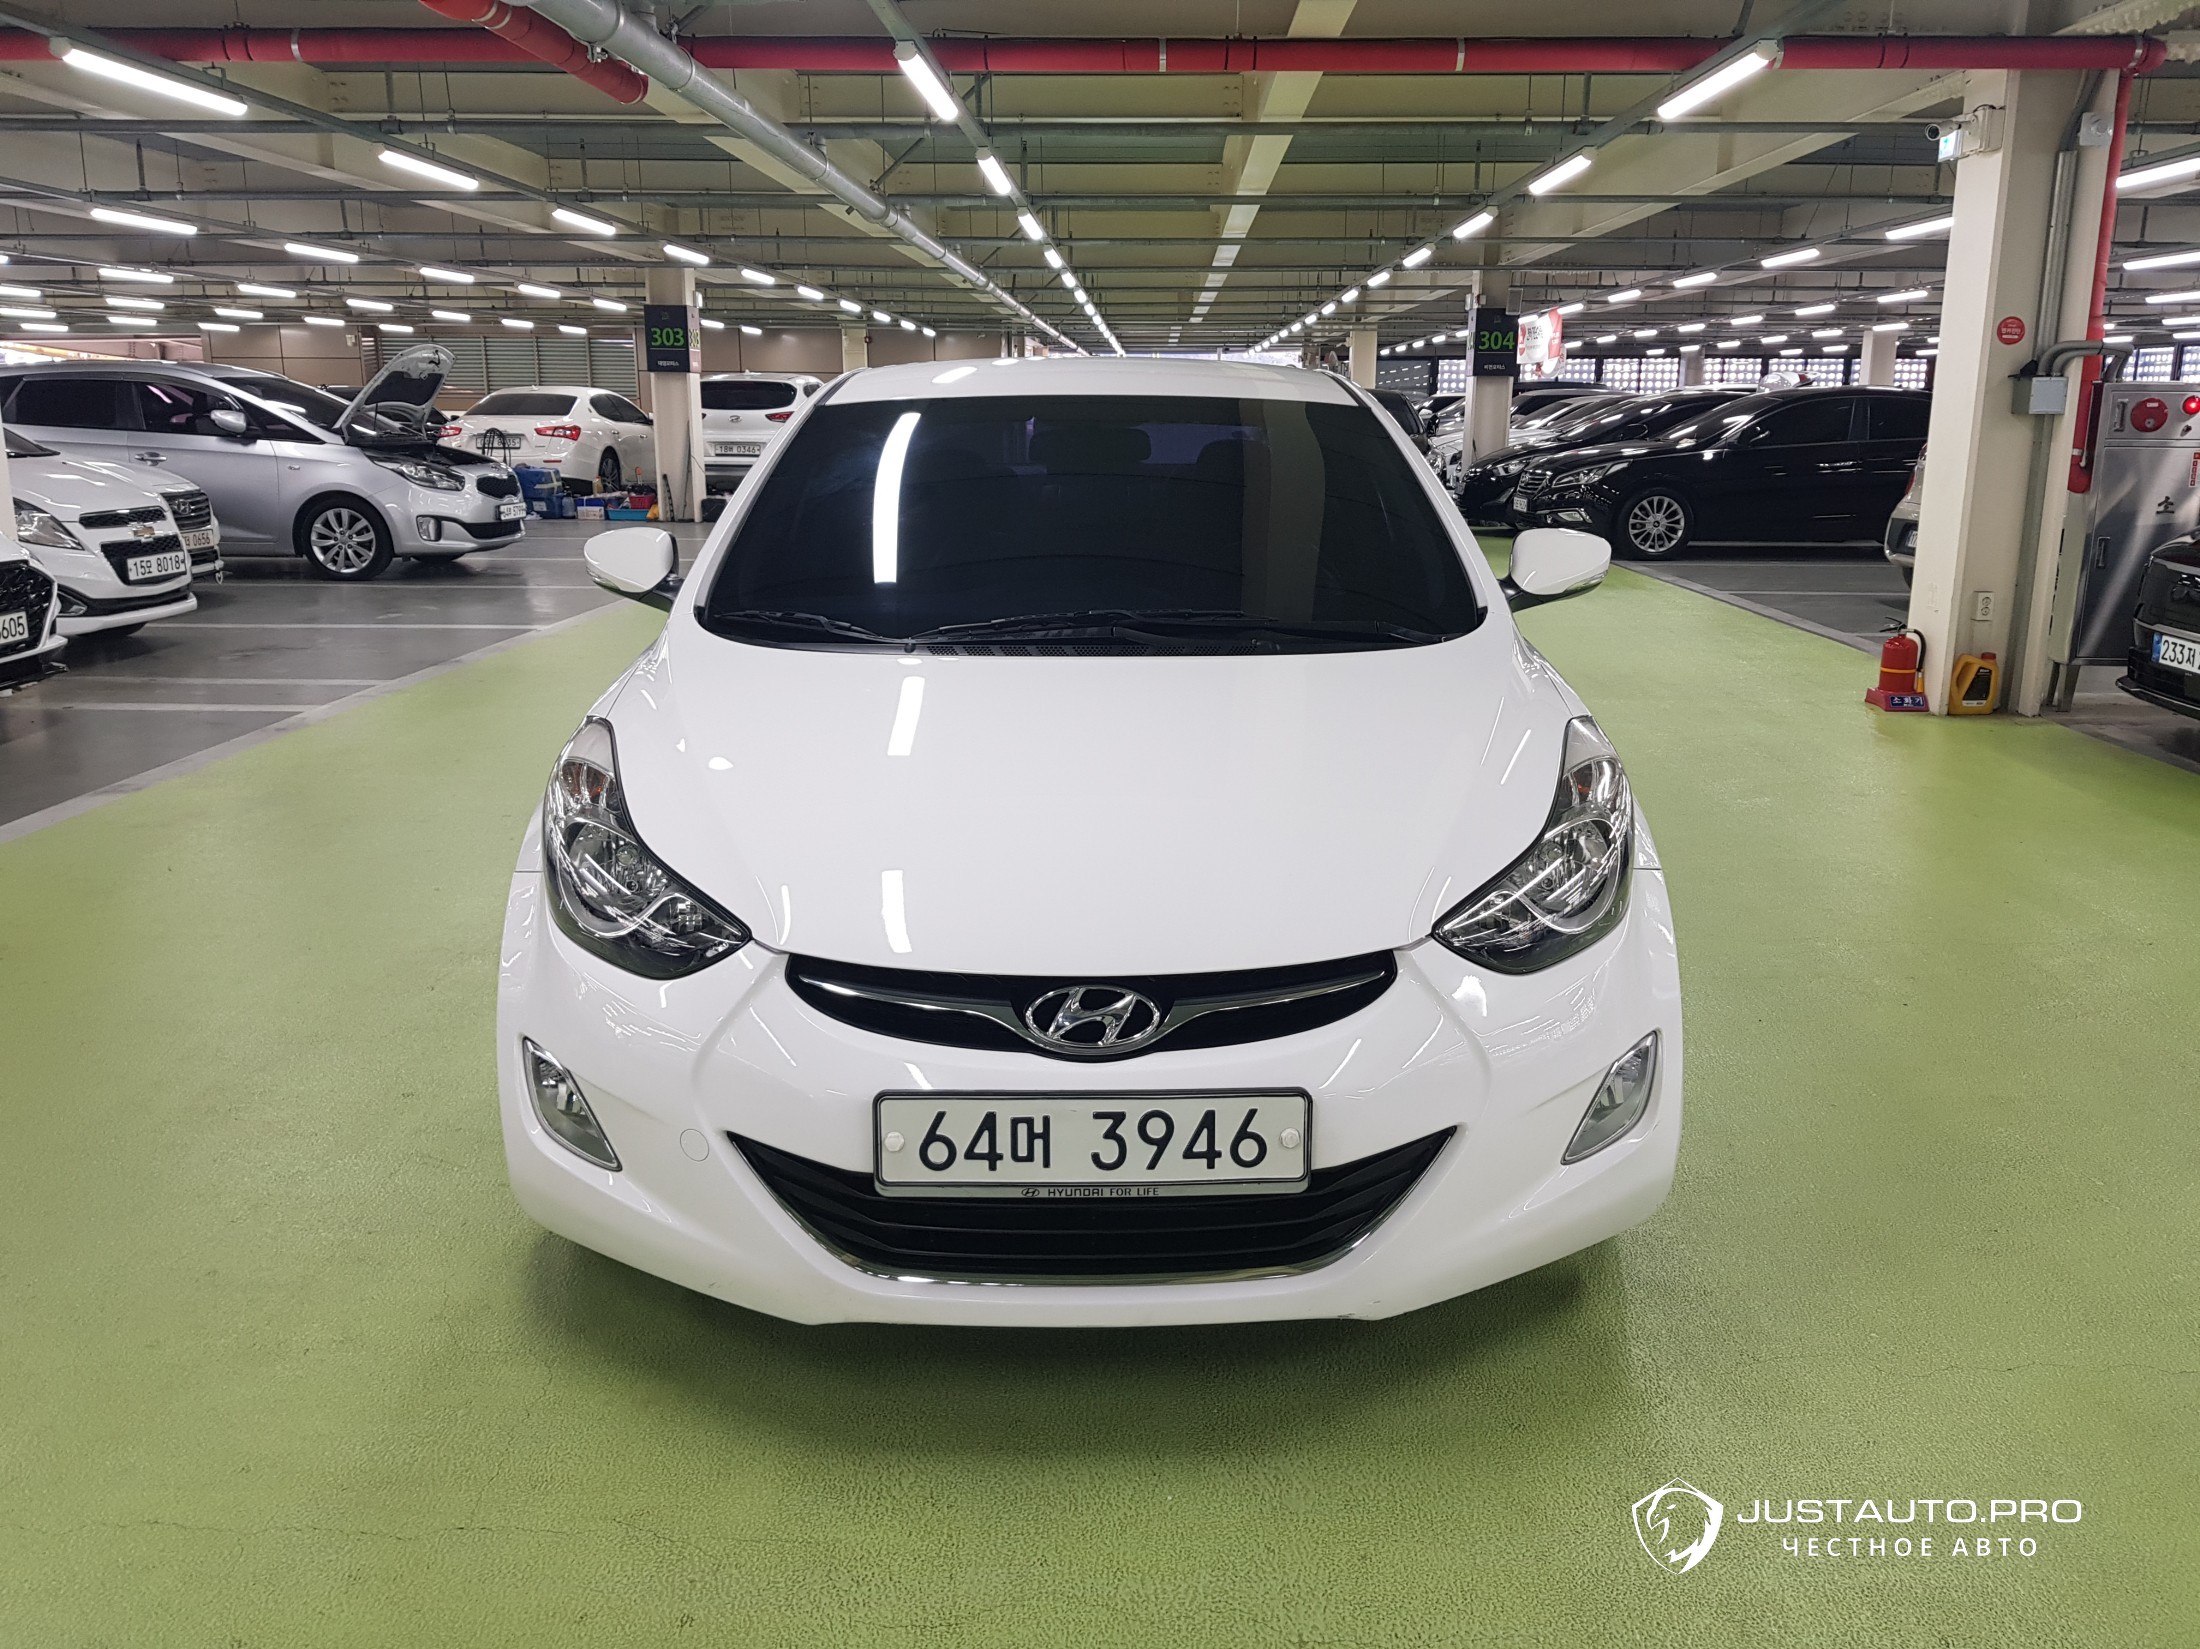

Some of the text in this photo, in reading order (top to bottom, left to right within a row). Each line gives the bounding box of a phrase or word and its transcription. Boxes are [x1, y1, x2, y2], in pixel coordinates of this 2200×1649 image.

[650, 327, 685, 346] 303
[1478, 331, 1515, 350] 304
[737, 445, 756, 454] 0346
[193, 532, 210, 546] 0656
[156, 554, 180, 573] 8018
[0, 615, 25, 639] 605
[2161, 639, 2196, 667] 233저
[1892, 695, 1924, 706] 소화기
[918, 1107, 1268, 1172] 64머 3946
[1047, 1187, 1160, 1198] HYUNDAI FOR LIFE
